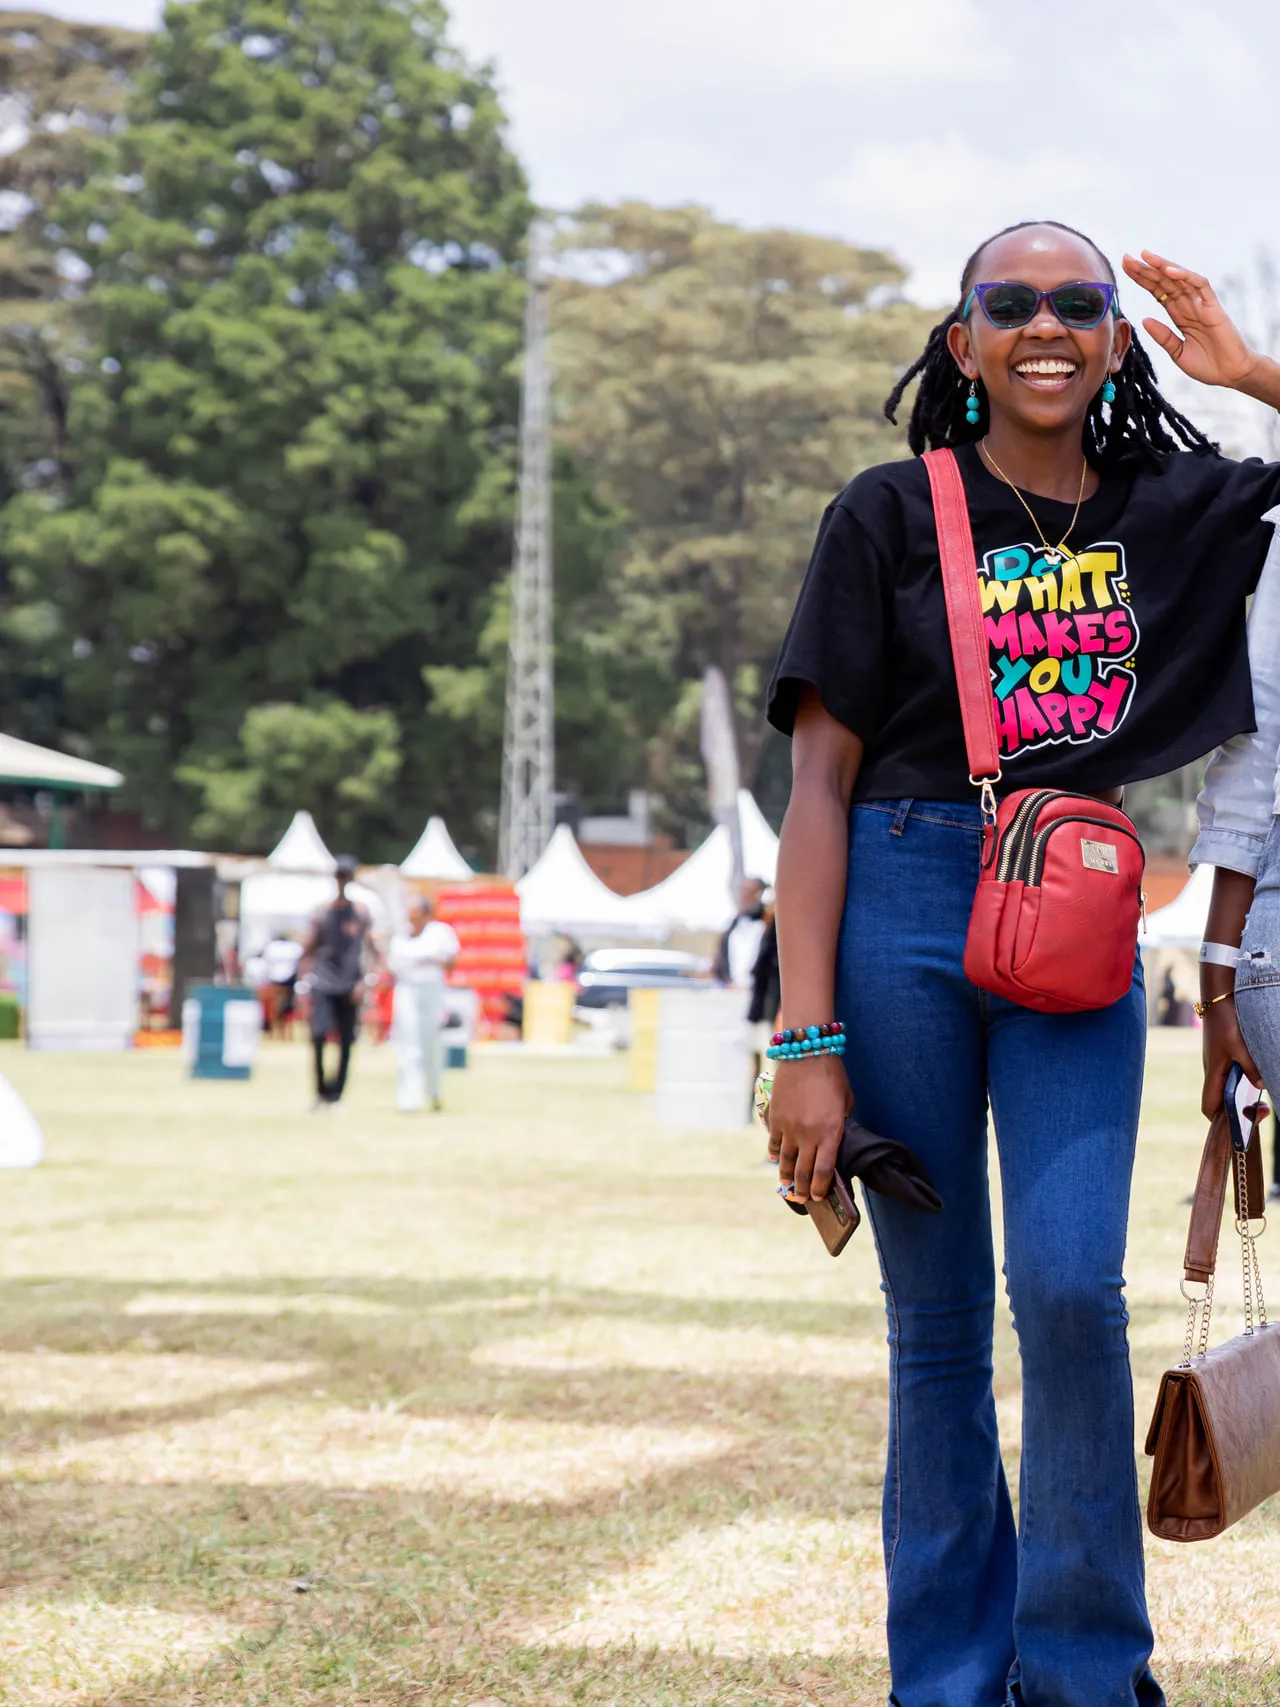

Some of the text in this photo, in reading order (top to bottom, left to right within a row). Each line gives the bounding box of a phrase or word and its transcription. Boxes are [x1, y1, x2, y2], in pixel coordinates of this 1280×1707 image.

[978, 543, 1118, 614] WHAT
[984, 610, 1132, 662] MAKES
[994, 654, 1092, 702] YOU
[992, 675, 1130, 753] HAPPY
